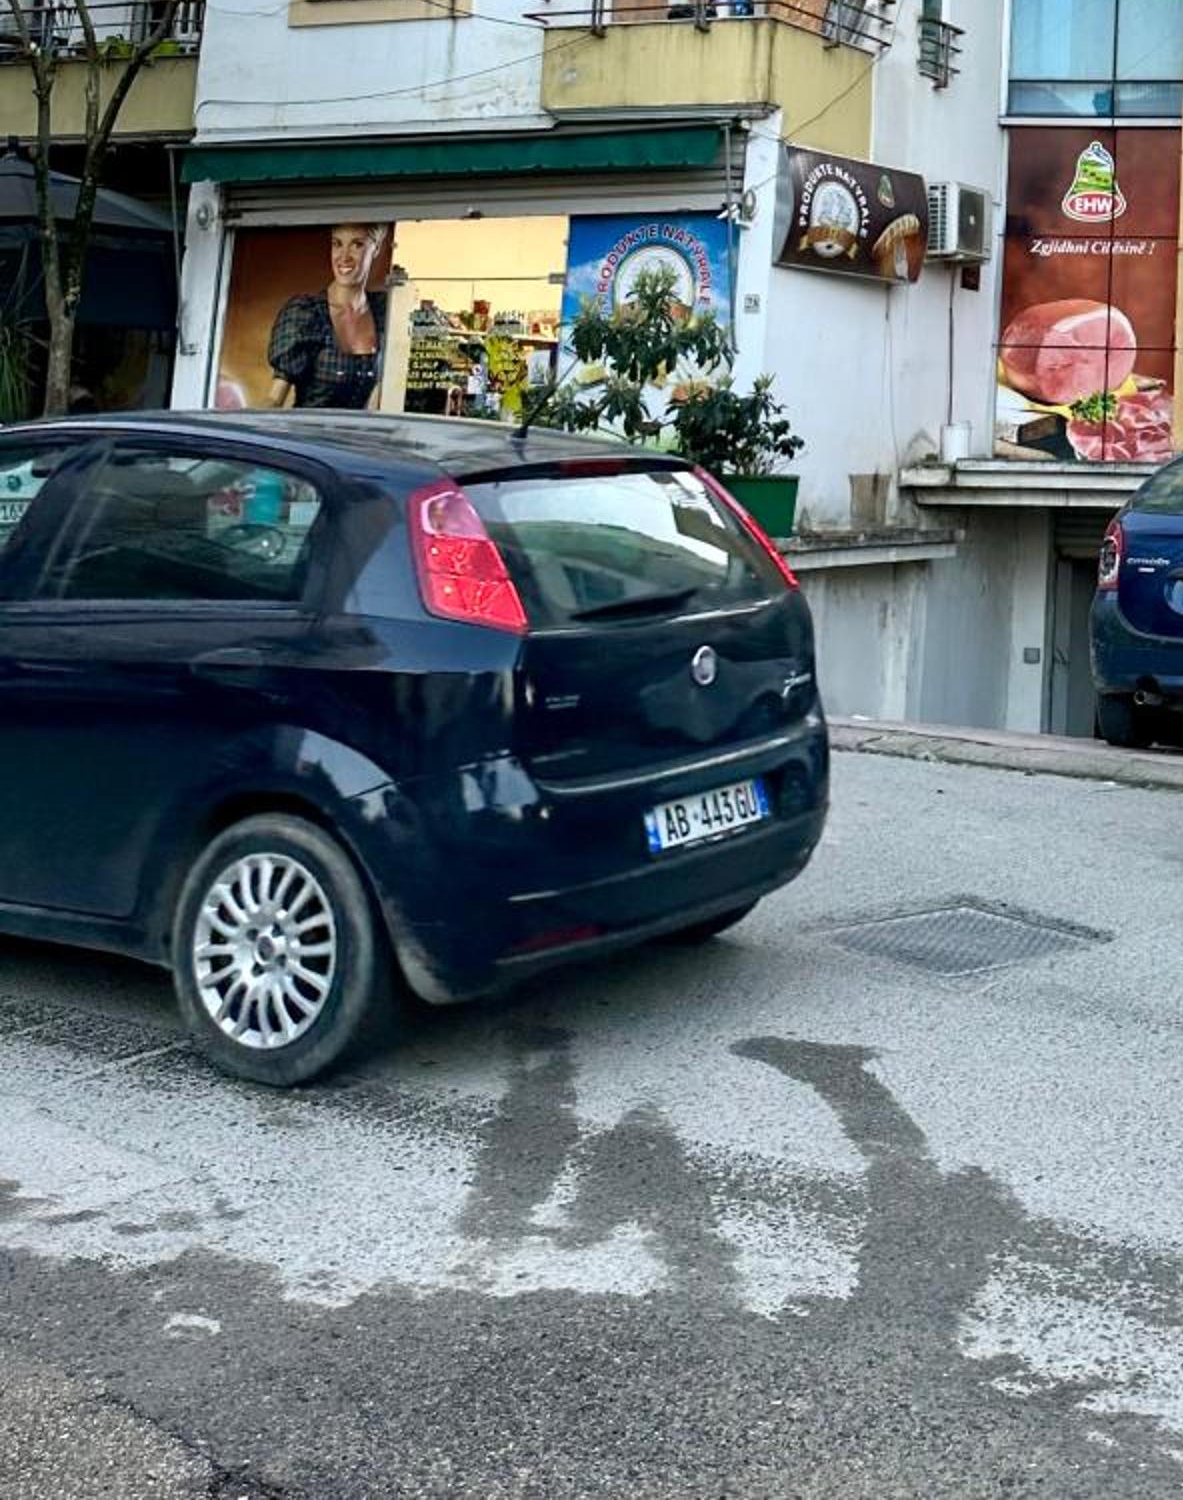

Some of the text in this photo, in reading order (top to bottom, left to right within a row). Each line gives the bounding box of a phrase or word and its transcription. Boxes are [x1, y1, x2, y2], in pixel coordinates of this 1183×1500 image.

[799, 163, 871, 239] PRODUKTE NATYRALE
[1074, 197, 1114, 213] EHW
[1030, 239, 1089, 257] Zgjidhni
[665, 804, 691, 842] AB
